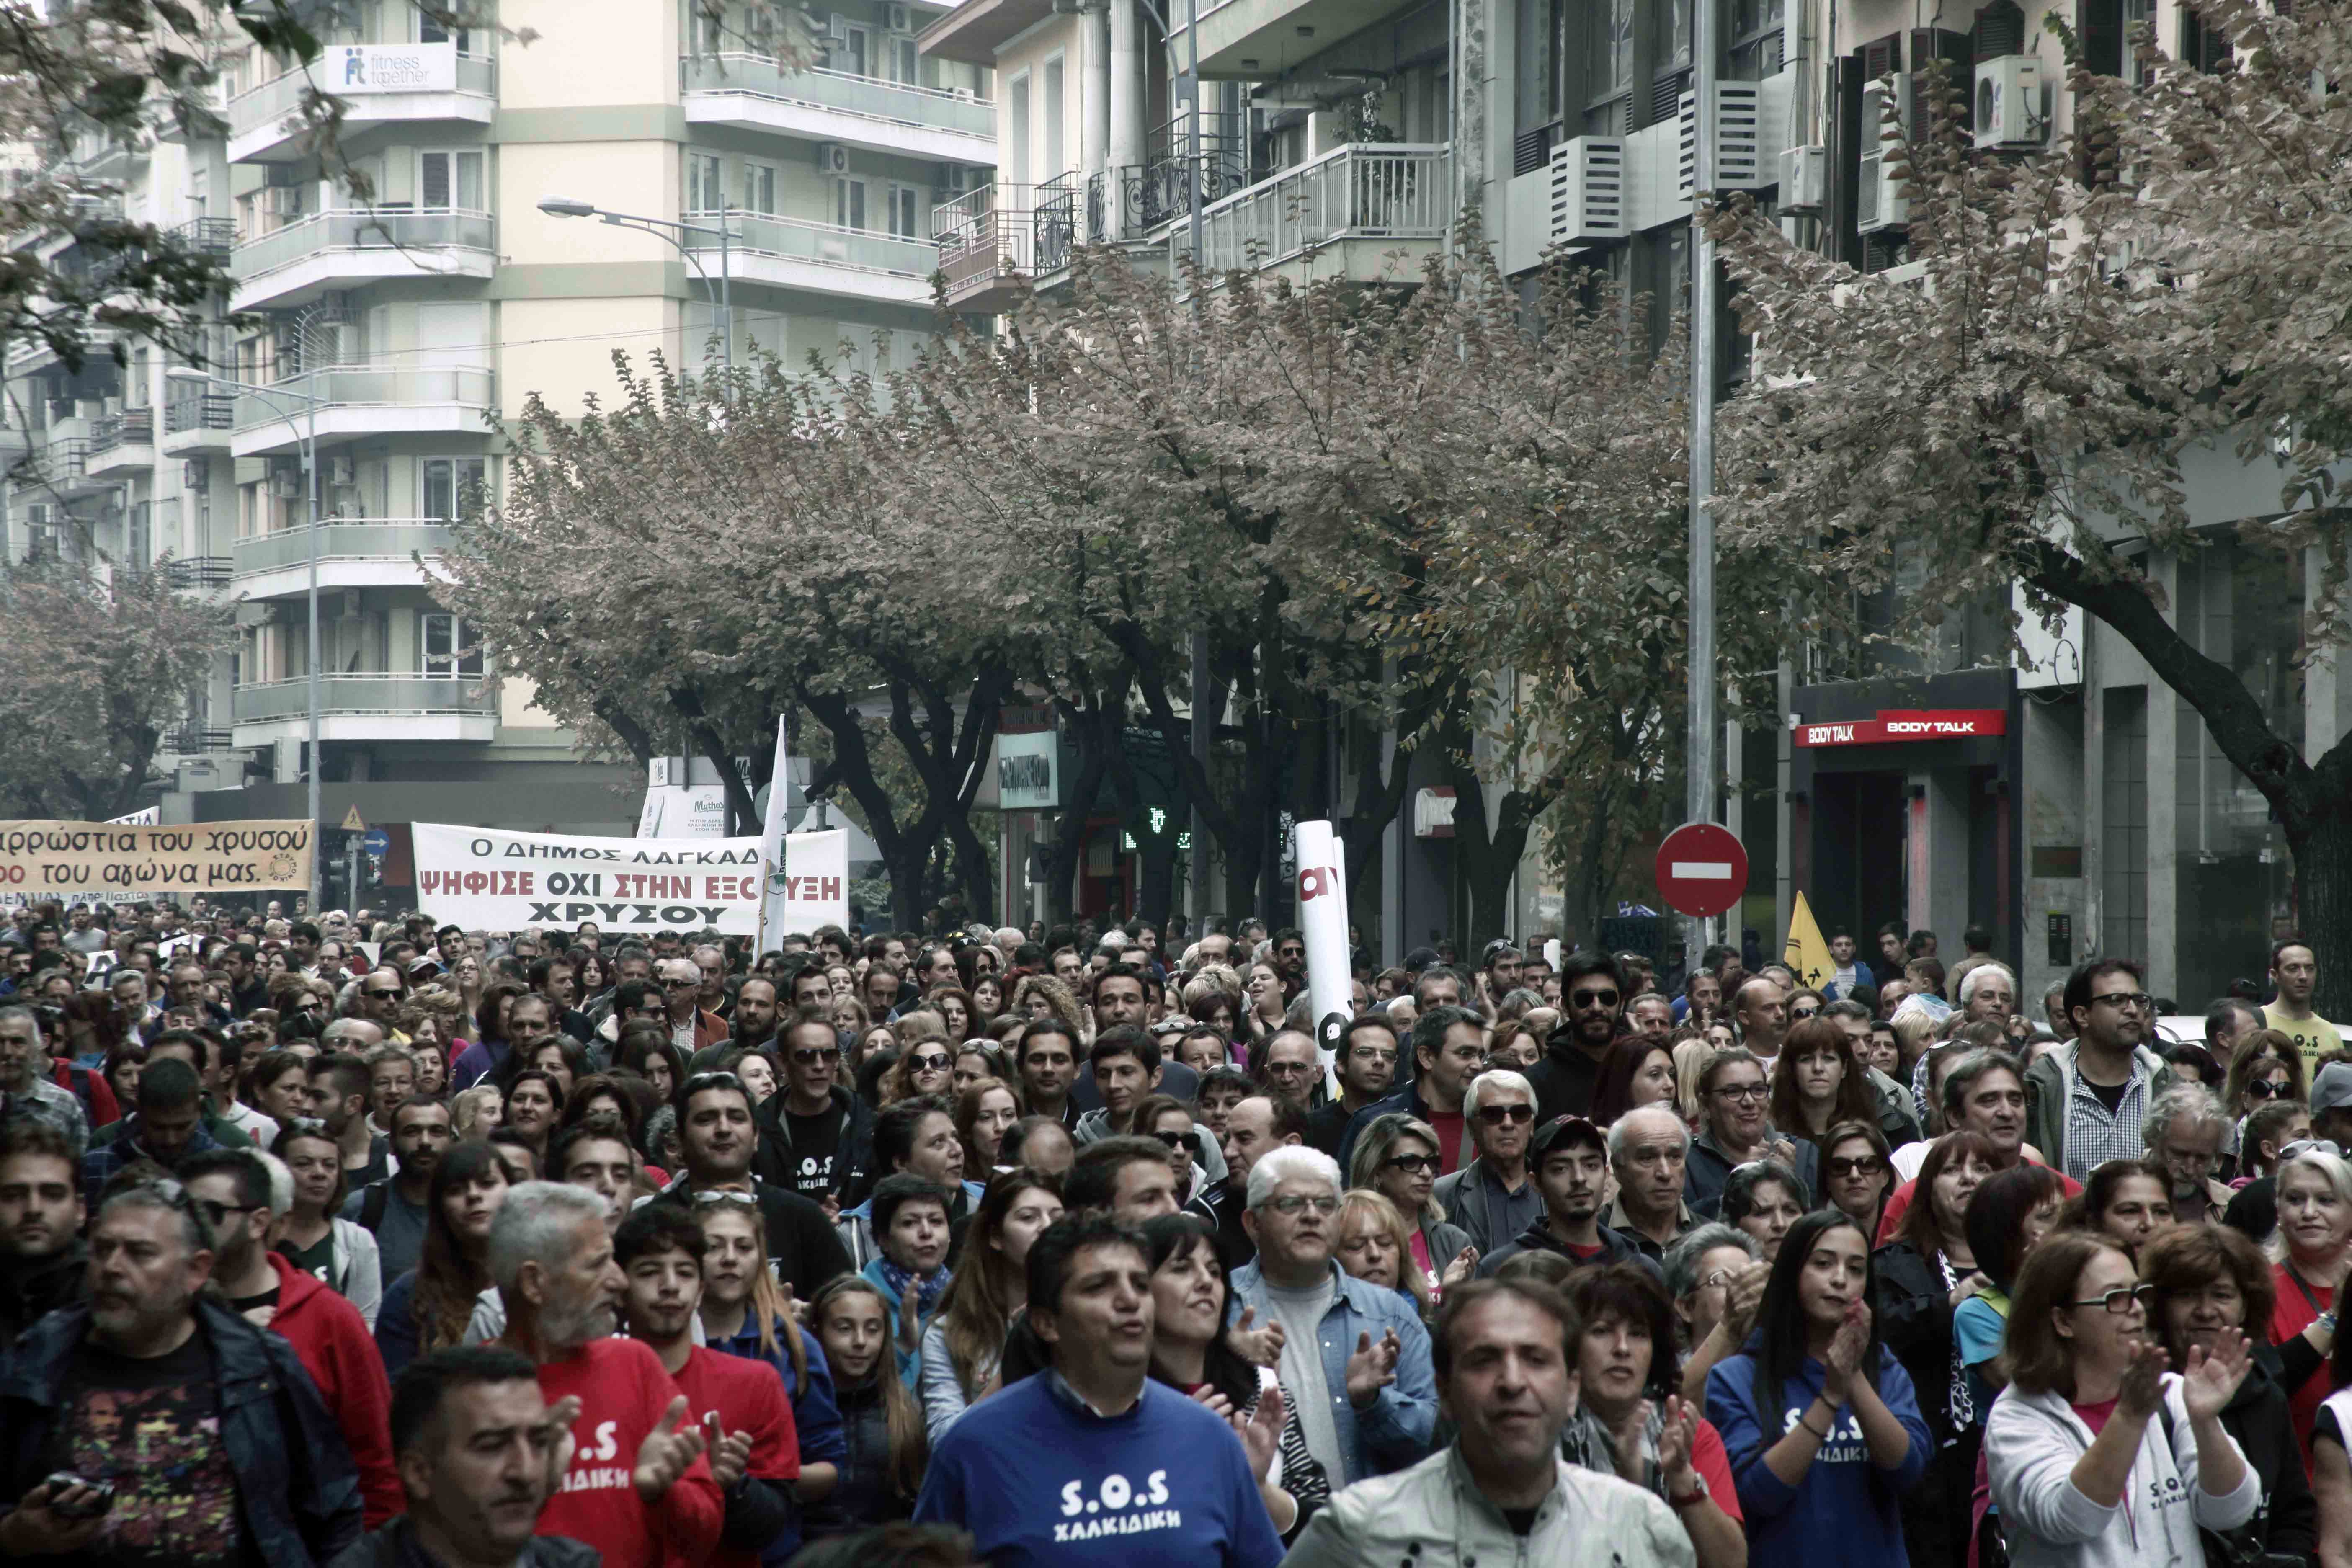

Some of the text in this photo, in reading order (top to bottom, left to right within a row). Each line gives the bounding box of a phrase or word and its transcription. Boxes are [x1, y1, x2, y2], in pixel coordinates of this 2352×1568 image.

[371, 54, 419, 70] fitness
[371, 69, 429, 87] together
[1809, 725, 1854, 744] BODY TALK
[1888, 722, 1974, 732] BODY TALK
[148, 833, 193, 851] του
[205, 825, 307, 856] χρυσού
[471, 838, 493, 857] Ο
[503, 842, 621, 861] ΔΗΜΟΣ
[42, 864, 90, 884] του
[103, 858, 198, 887] αγώνα
[208, 864, 261, 887] μας.
[420, 871, 841, 901] ΨΗΦΙΣΕ ΟΧΙ ΣΤΗΝ ΕΞΟΥΞΗ
[526, 903, 728, 924] ΧΡΥΣΟΥ
[1061, 1469, 1169, 1516] S.O.S
[1053, 1509, 1181, 1542] ΧΑΛΚΙΔΙΚΗ
